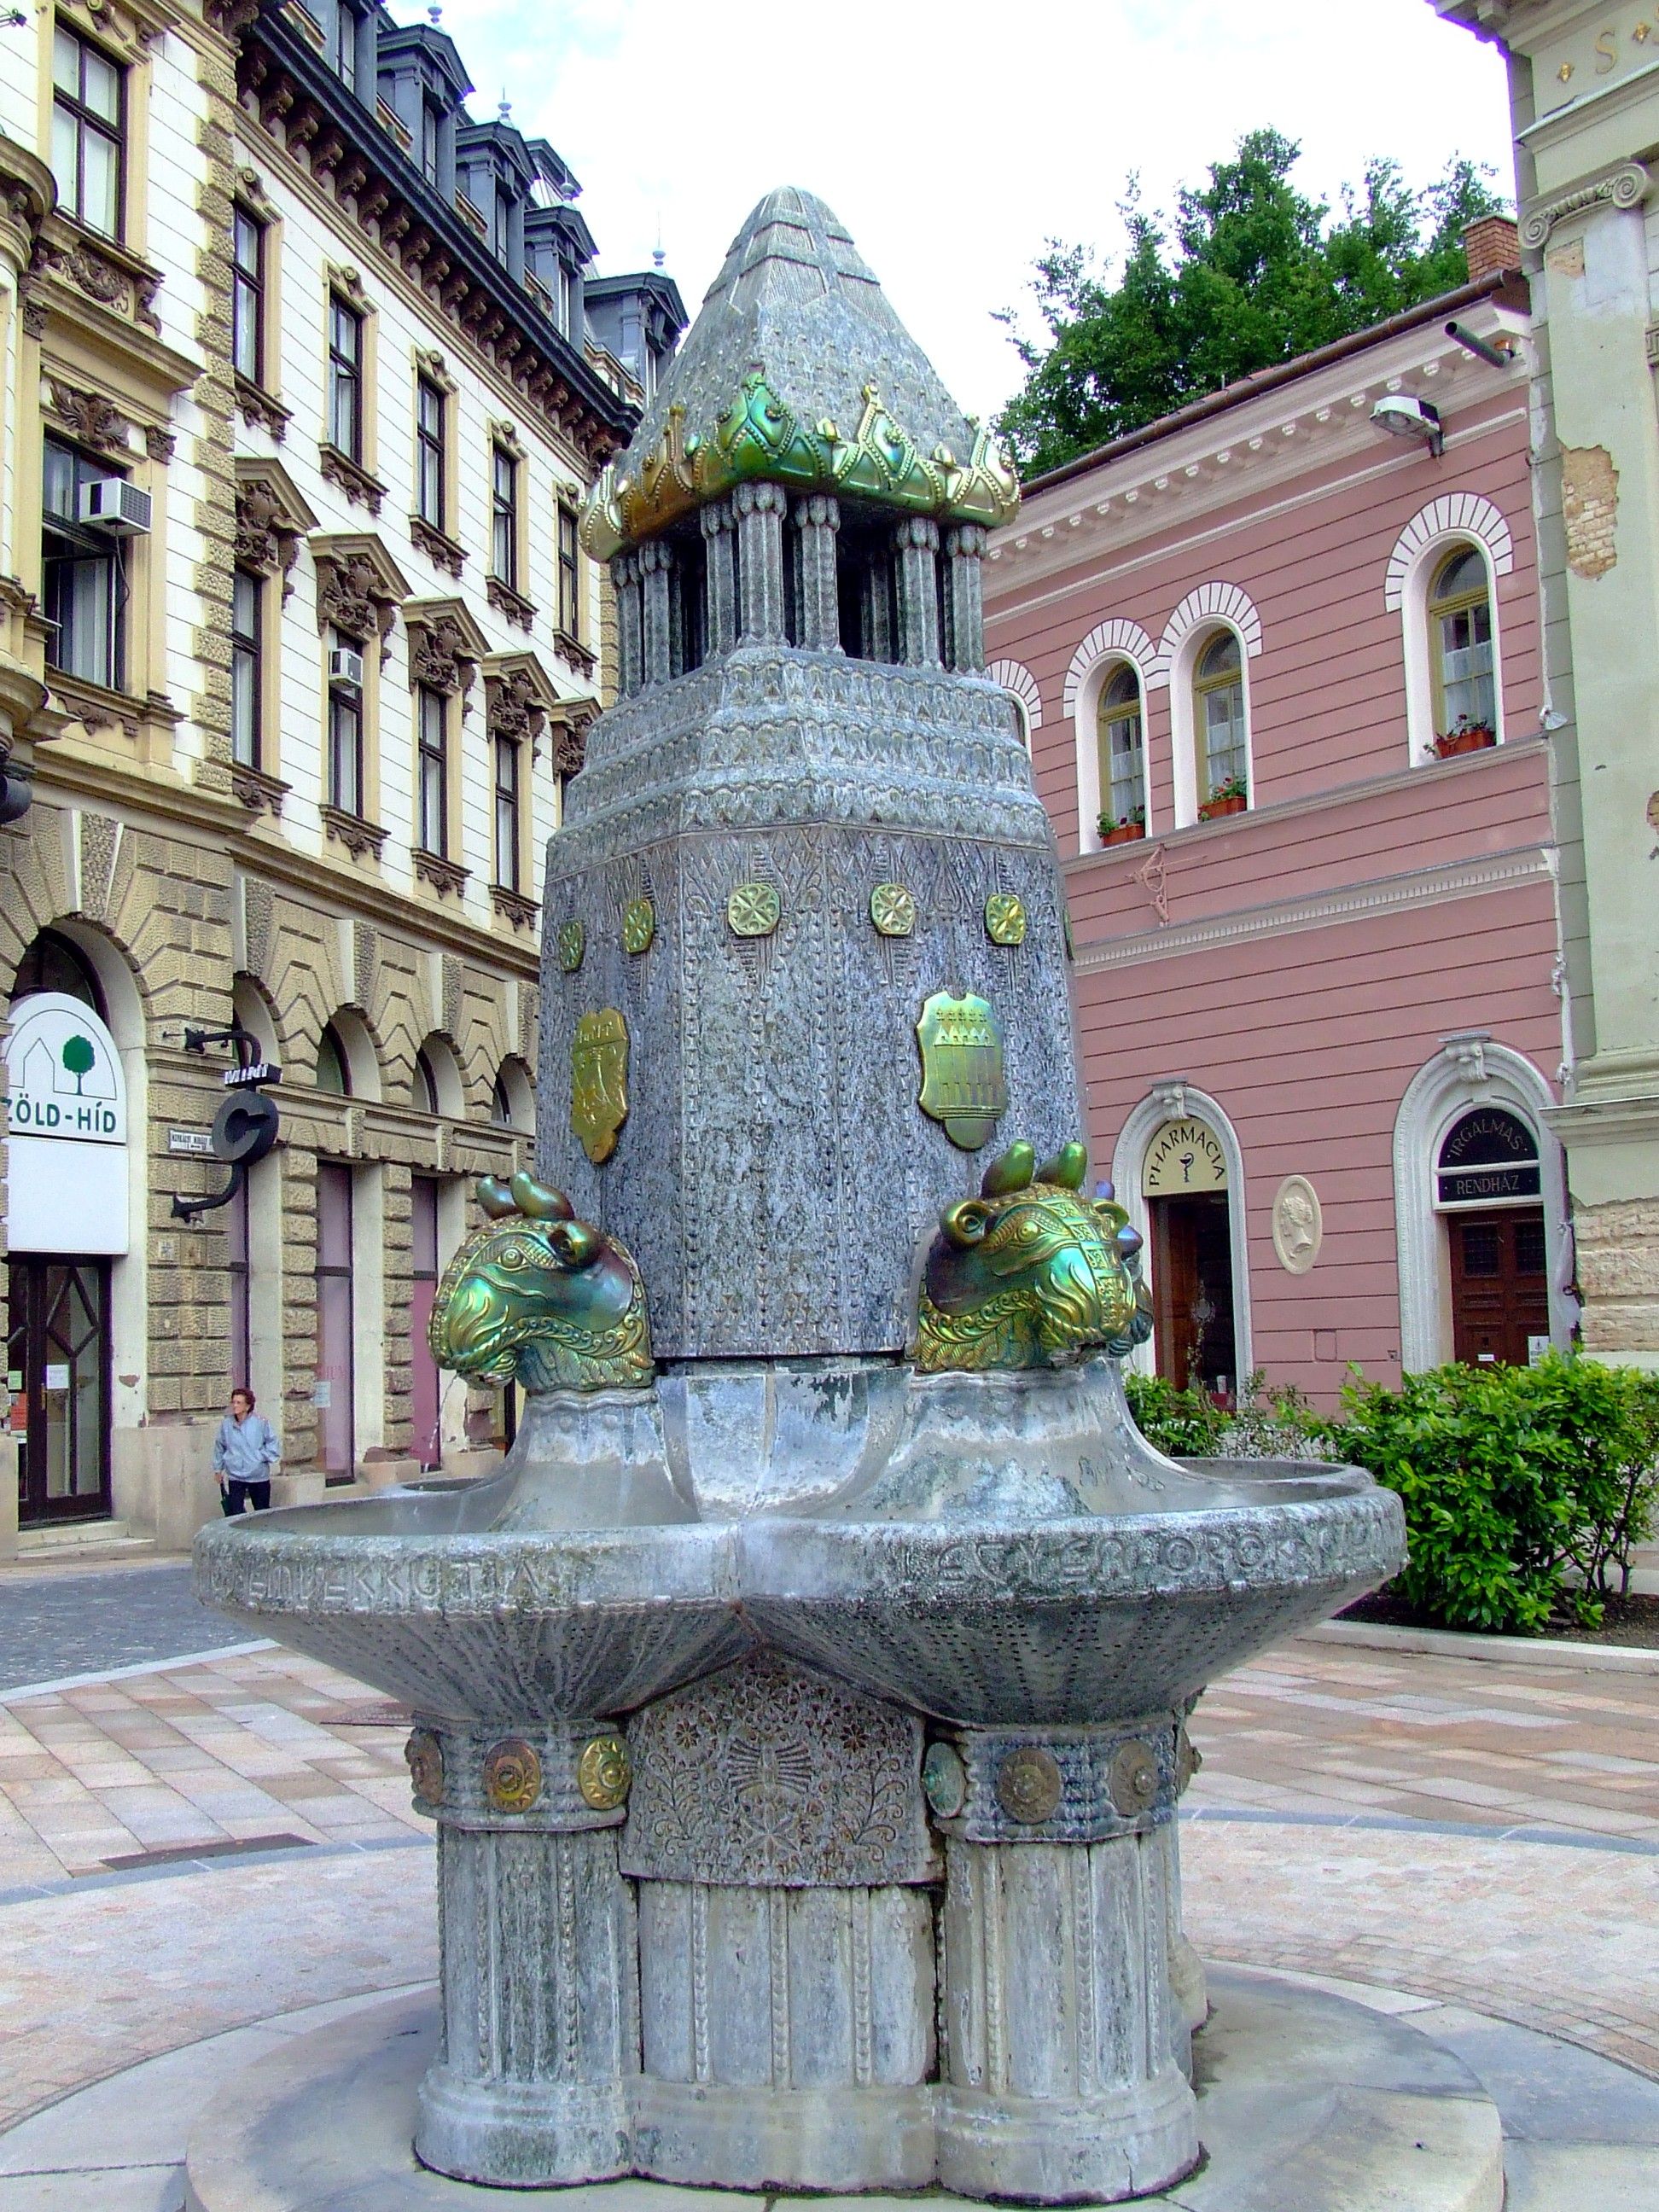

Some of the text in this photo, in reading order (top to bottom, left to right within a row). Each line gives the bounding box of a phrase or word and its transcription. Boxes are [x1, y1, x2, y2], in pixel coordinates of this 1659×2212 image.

[1449, 1119, 1524, 1156] IRGALMAS
[1149, 1126, 1225, 1187] PHARMACIA
[1457, 1173, 1520, 1196] RENDHÁZ
